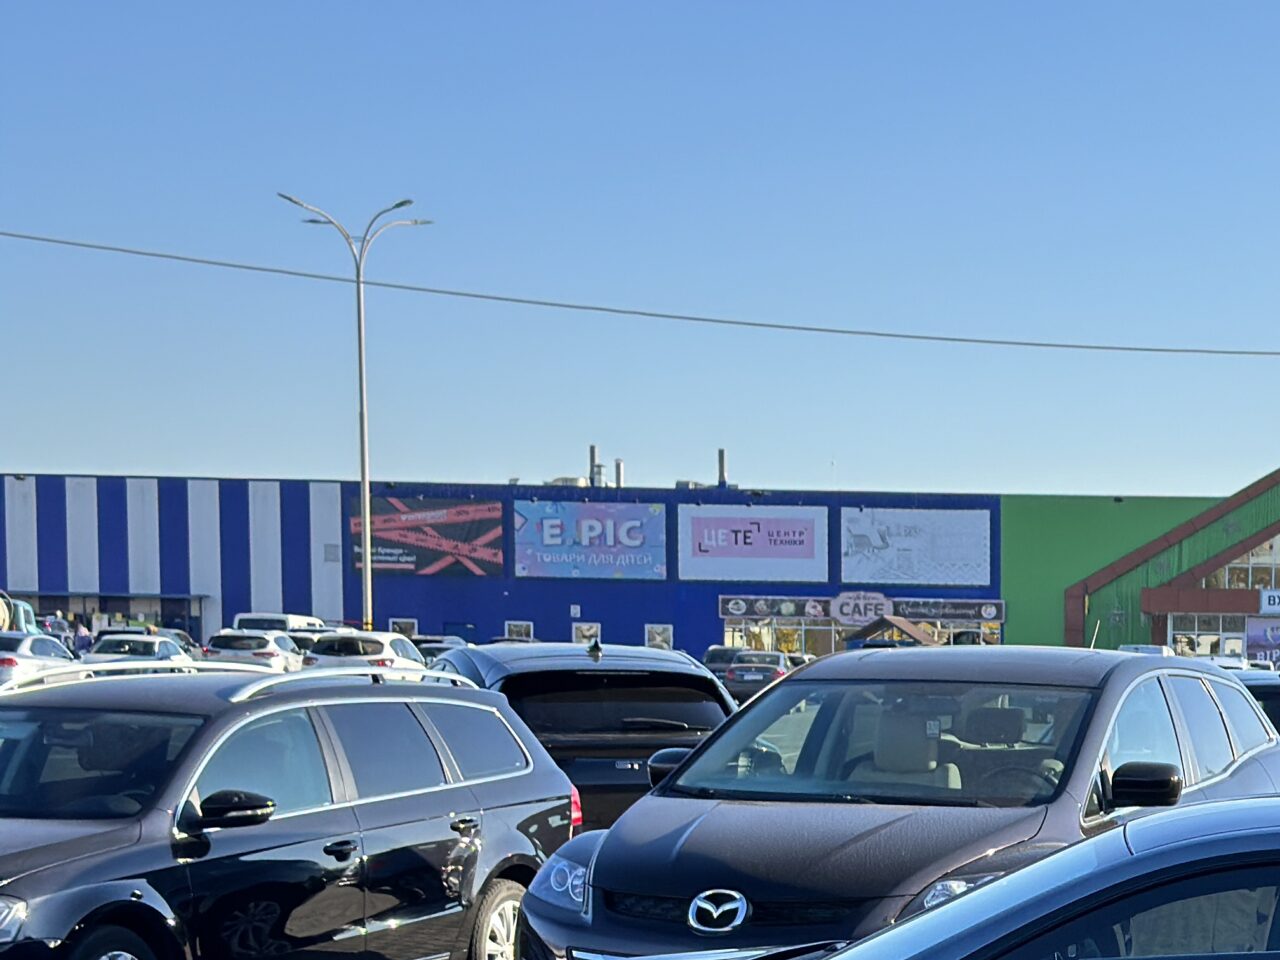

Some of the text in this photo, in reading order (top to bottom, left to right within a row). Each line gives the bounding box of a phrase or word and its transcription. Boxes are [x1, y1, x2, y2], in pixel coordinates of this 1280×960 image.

[767, 530, 805, 538] ЦЕНТР
[768, 538, 805, 546] ТЕХНІКИ
[536, 552, 653, 566] ТОВАРИ ДЛЯ ДІТЕЙ
[840, 602, 885, 617] CAFE
